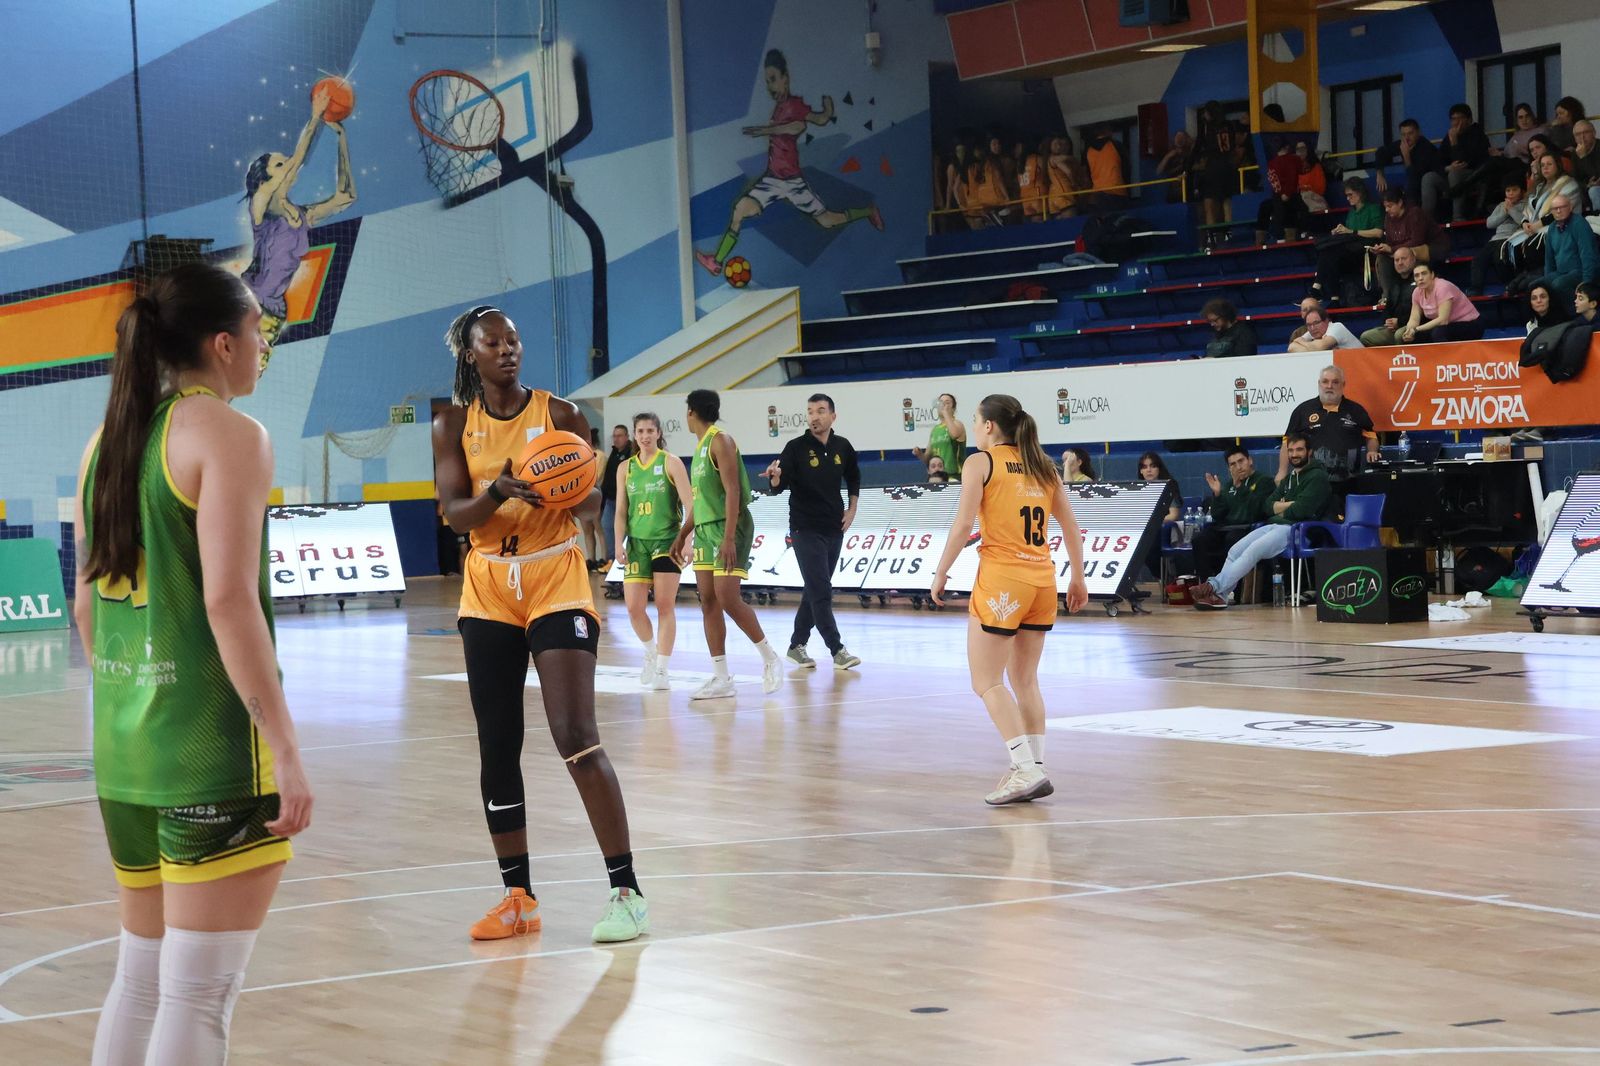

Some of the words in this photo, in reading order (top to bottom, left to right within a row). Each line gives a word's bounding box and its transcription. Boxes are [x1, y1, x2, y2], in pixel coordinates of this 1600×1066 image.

[1071, 396, 1110, 414] ZAMORA
[1250, 386, 1296, 405] ZAMORA
[915, 407, 939, 421] ZAMO
[1431, 394, 1530, 426] ZAMORA
[530, 451, 581, 476] Wilson
[638, 501, 652, 516] 30
[1020, 505, 1046, 547] 13
[1049, 529, 1131, 553] aus
[269, 542, 385, 564] añus
[273, 564, 391, 584] erus
[839, 556, 923, 575] verus
